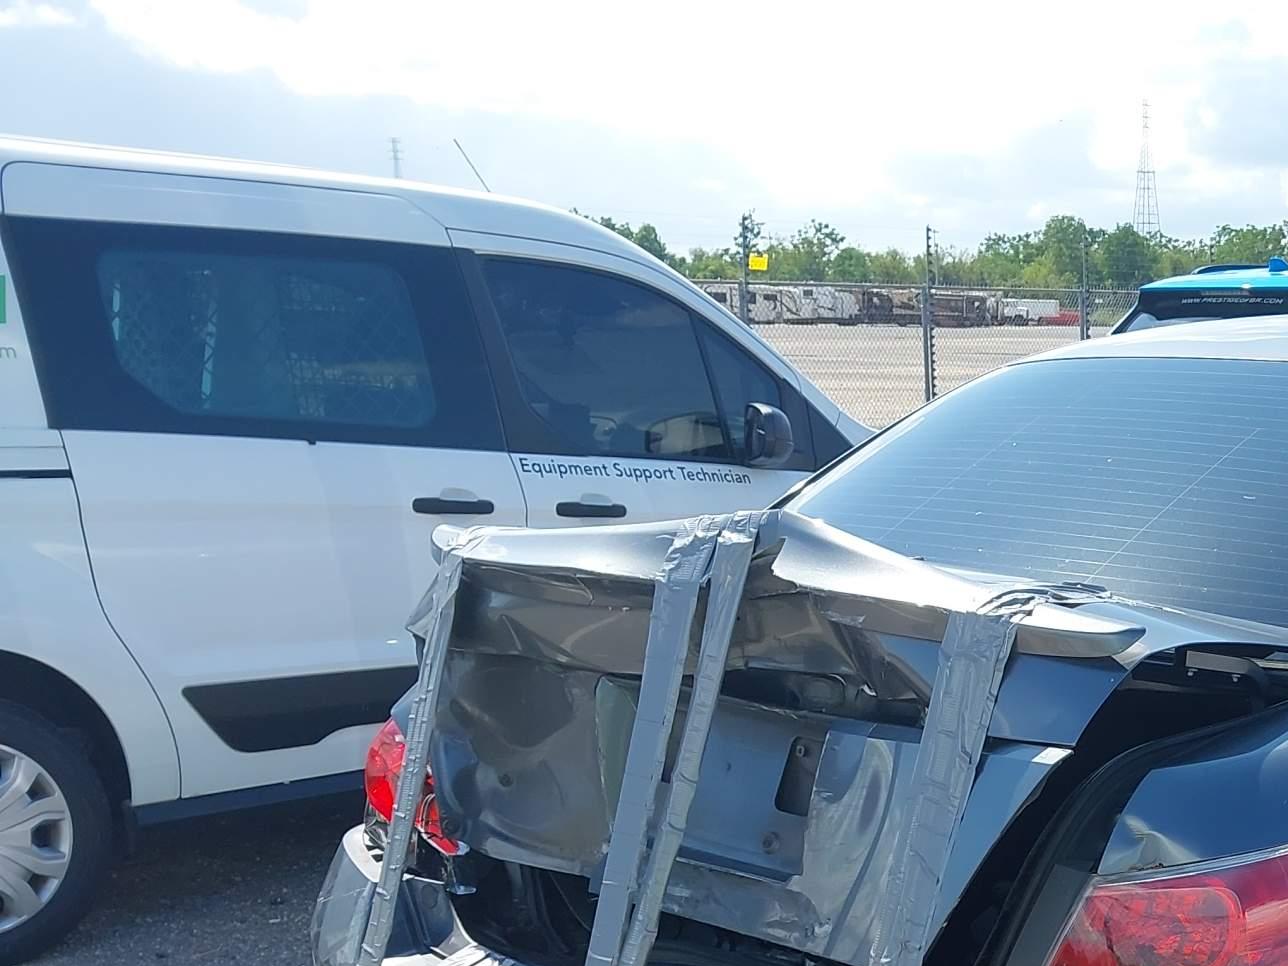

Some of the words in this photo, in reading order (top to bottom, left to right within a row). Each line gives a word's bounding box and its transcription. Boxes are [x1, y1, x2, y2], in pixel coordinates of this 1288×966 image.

[519, 457, 610, 479] Equipment
[613, 462, 676, 483] Support
[677, 466, 752, 485] Technician
